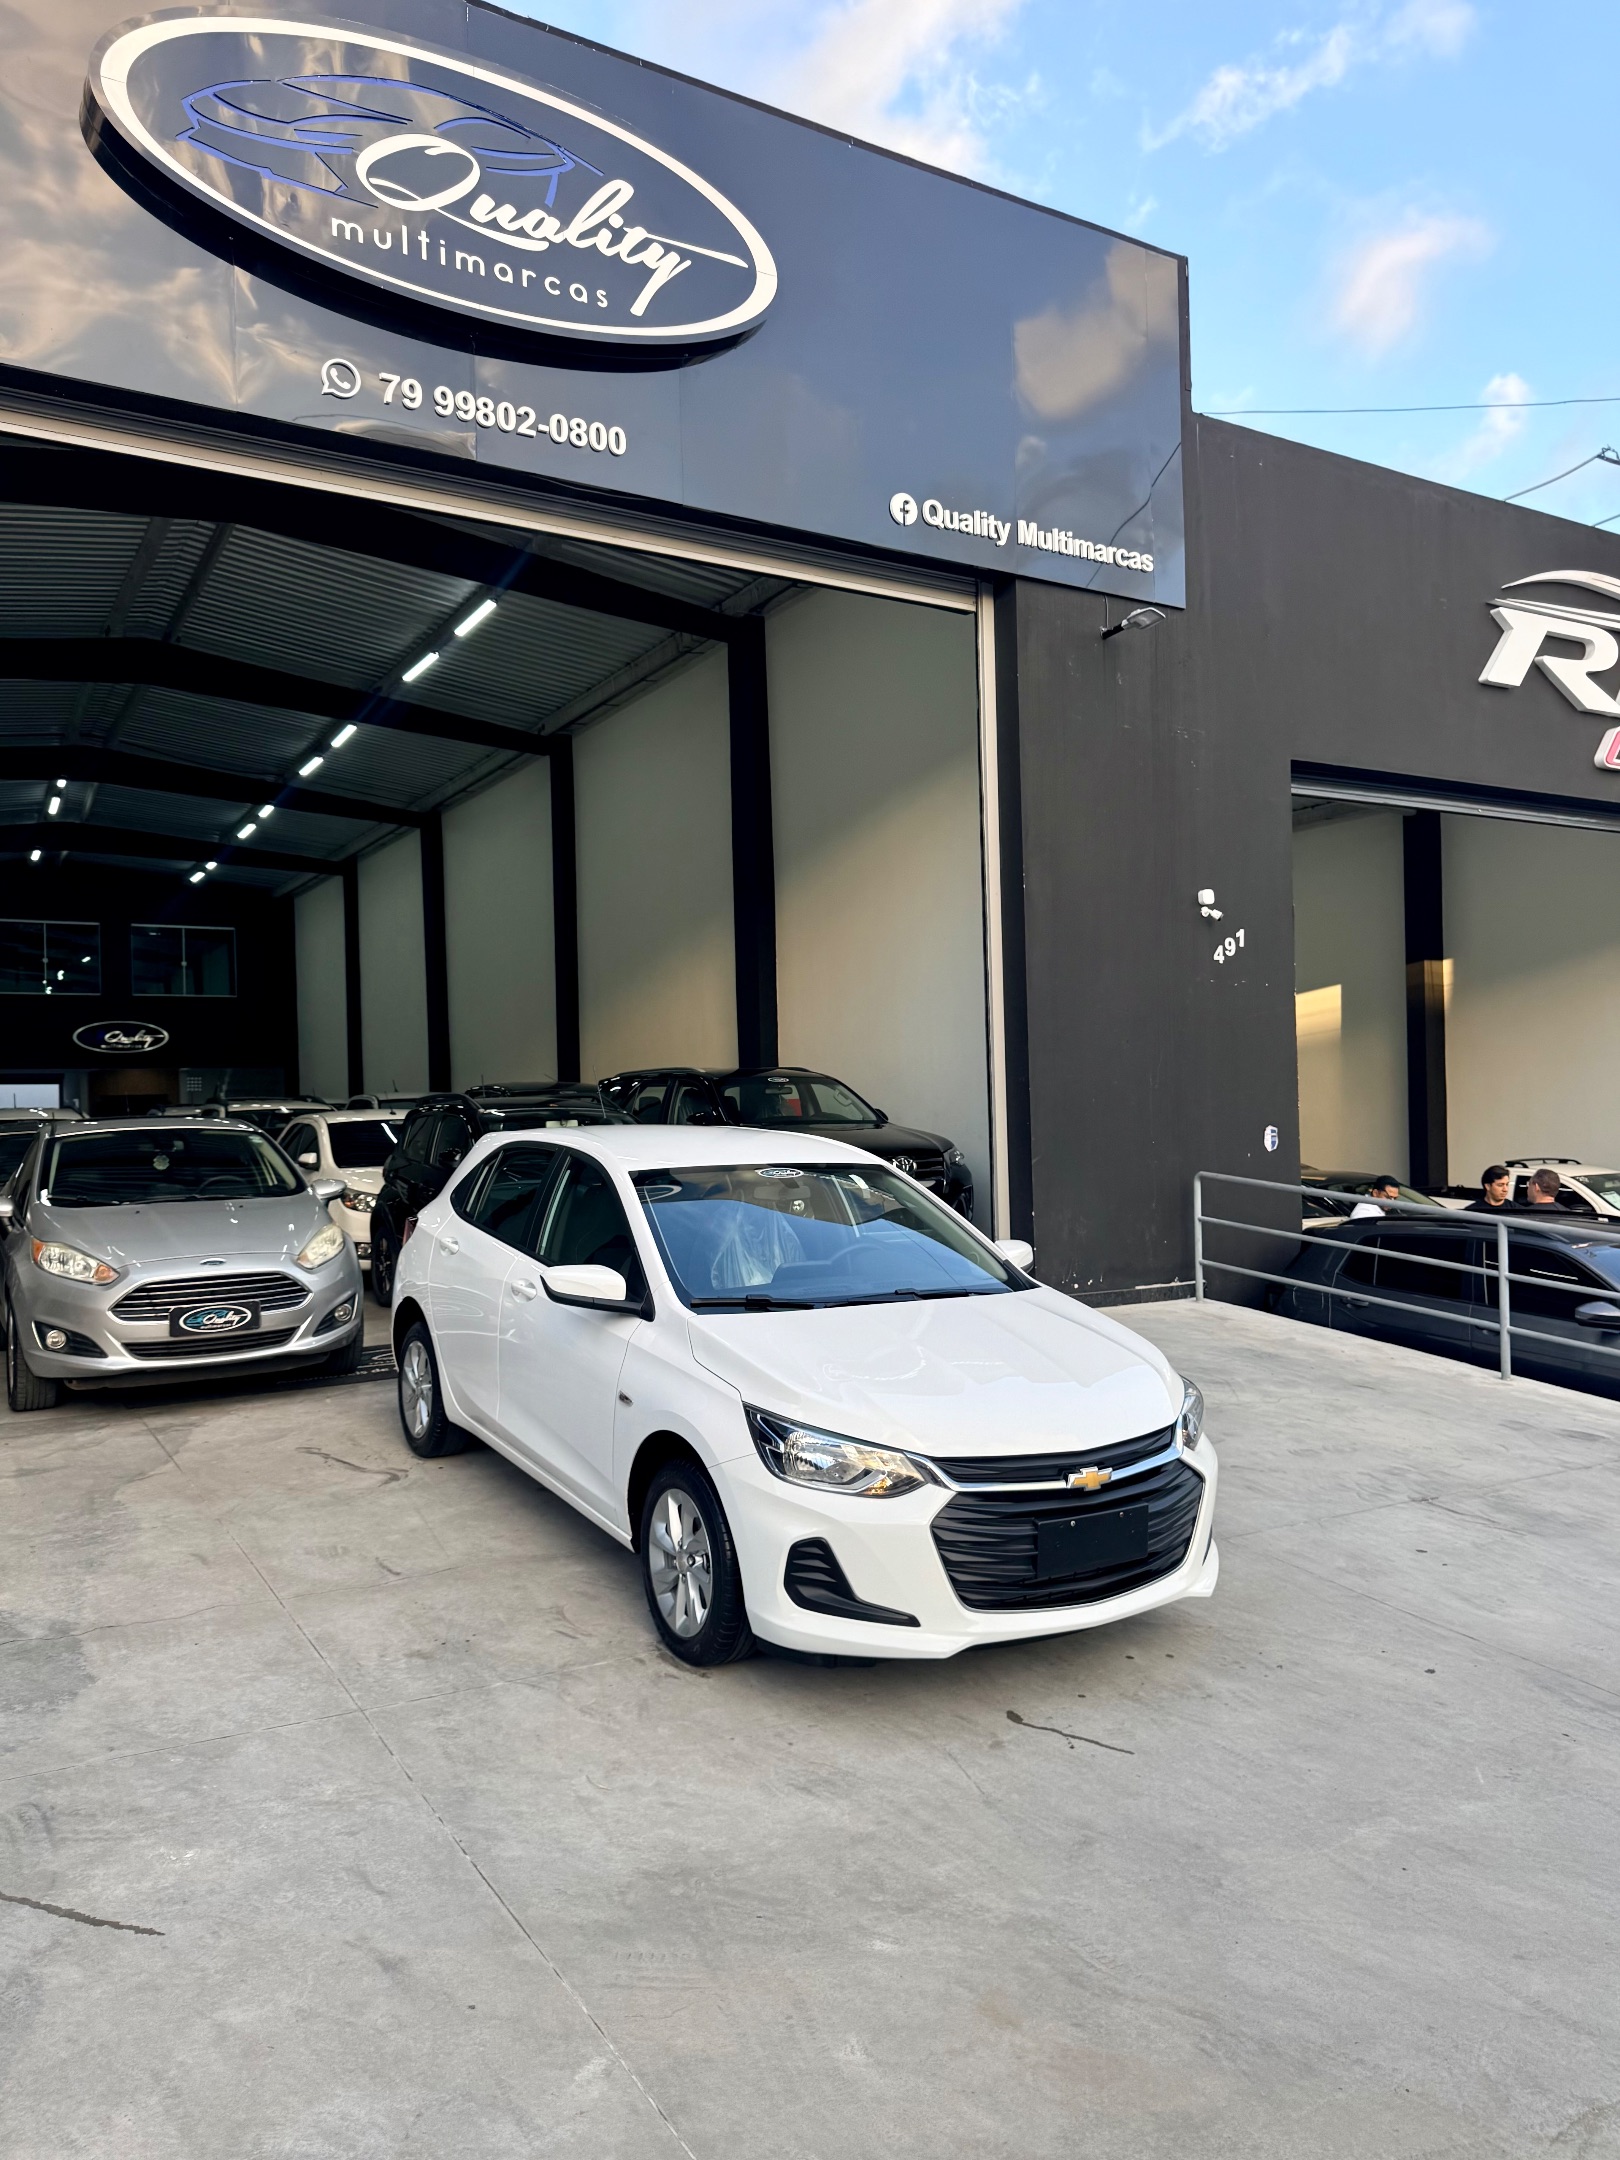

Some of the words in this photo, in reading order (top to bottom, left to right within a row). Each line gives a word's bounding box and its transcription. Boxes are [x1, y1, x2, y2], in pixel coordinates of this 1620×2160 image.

[331, 216, 609, 309] multimarcas
[356, 133, 747, 317] Quality
[378, 371, 424, 411] 79
[432, 385, 628, 457] 99802-0800
[922, 499, 1012, 547] Quality
[1016, 519, 1155, 573] Multimarcas
[1213, 928, 1245, 964] 491
